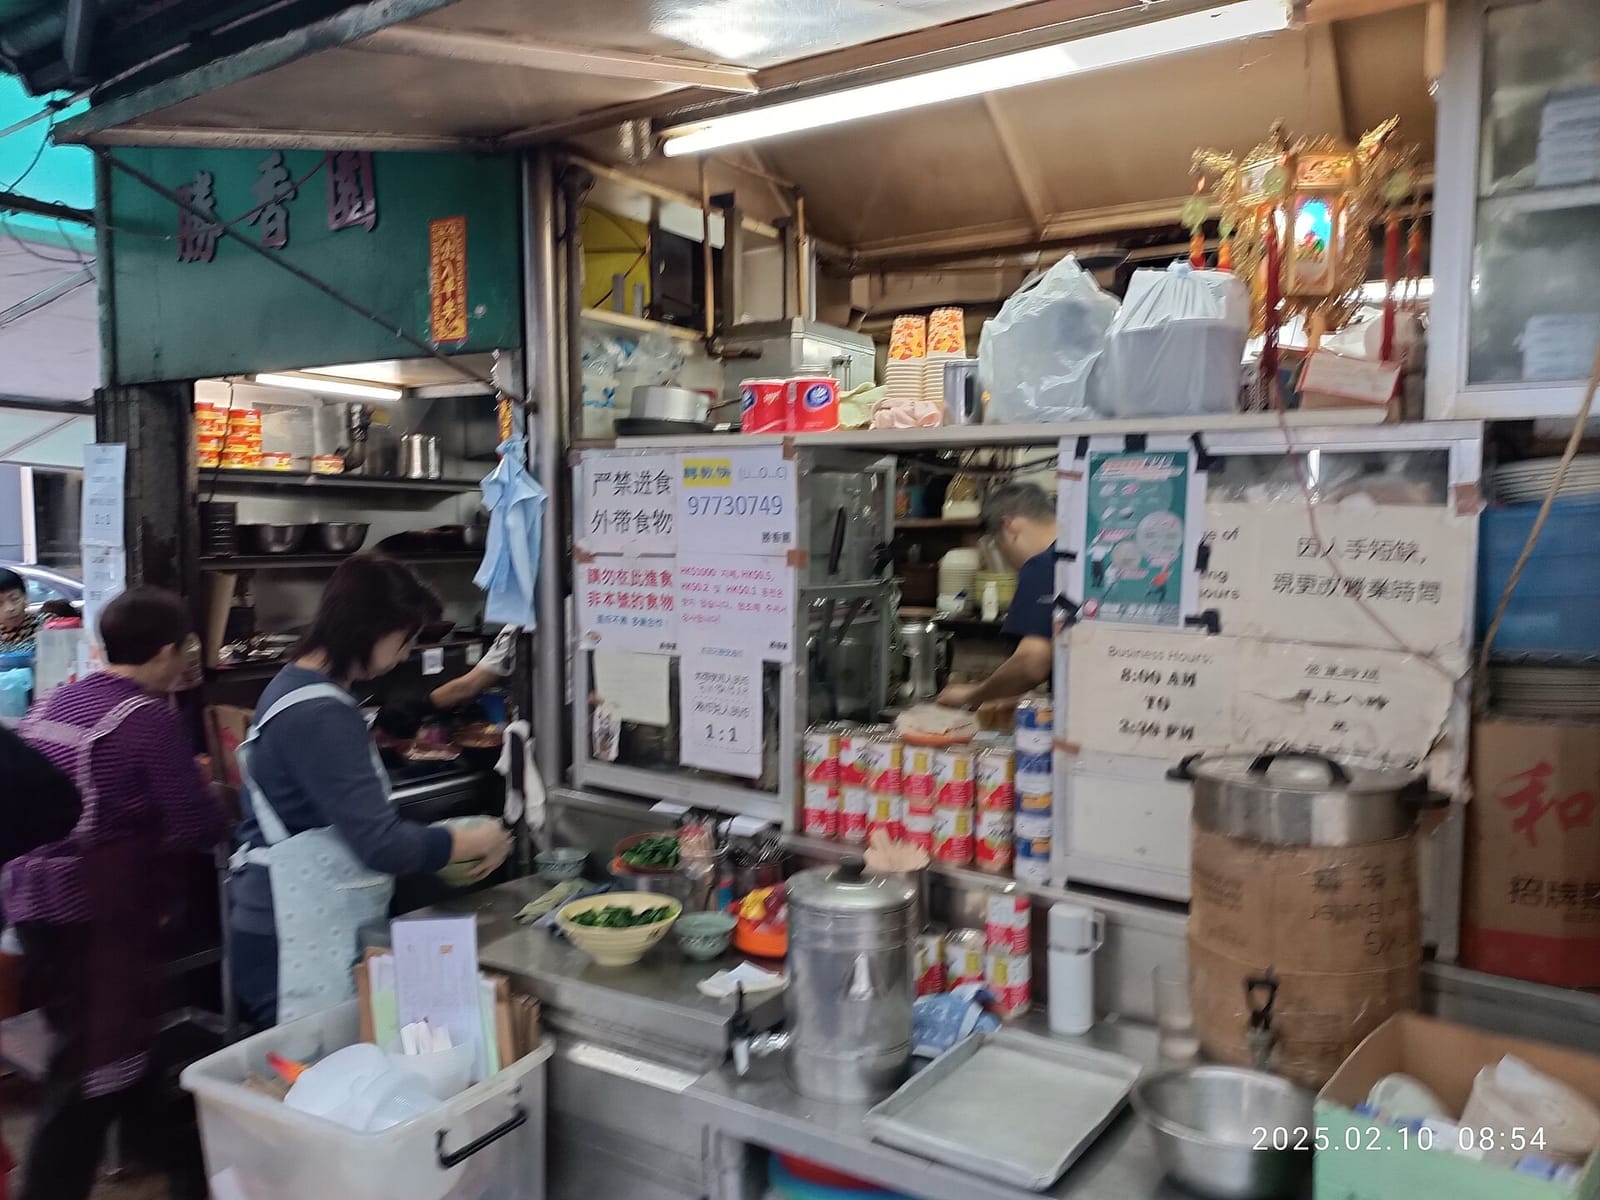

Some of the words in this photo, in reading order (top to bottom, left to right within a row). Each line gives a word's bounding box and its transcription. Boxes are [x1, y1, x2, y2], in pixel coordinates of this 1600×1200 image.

[591, 469, 673, 497] 严禁进食
[687, 495, 783, 516] 97730749
[590, 508, 673, 535] 外带食物
[1222, 527, 1240, 542] of
[587, 567, 673, 587] 請勿在此進食
[1108, 645, 1165, 661] Business
[1120, 667, 1161, 685] 8:00
[1167, 671, 1197, 687] AM
[1144, 695, 1171, 711] TO
[705, 723, 738, 743] 1:1
[1165, 723, 1195, 741] PM
[1497, 759, 1597, 849] 和
